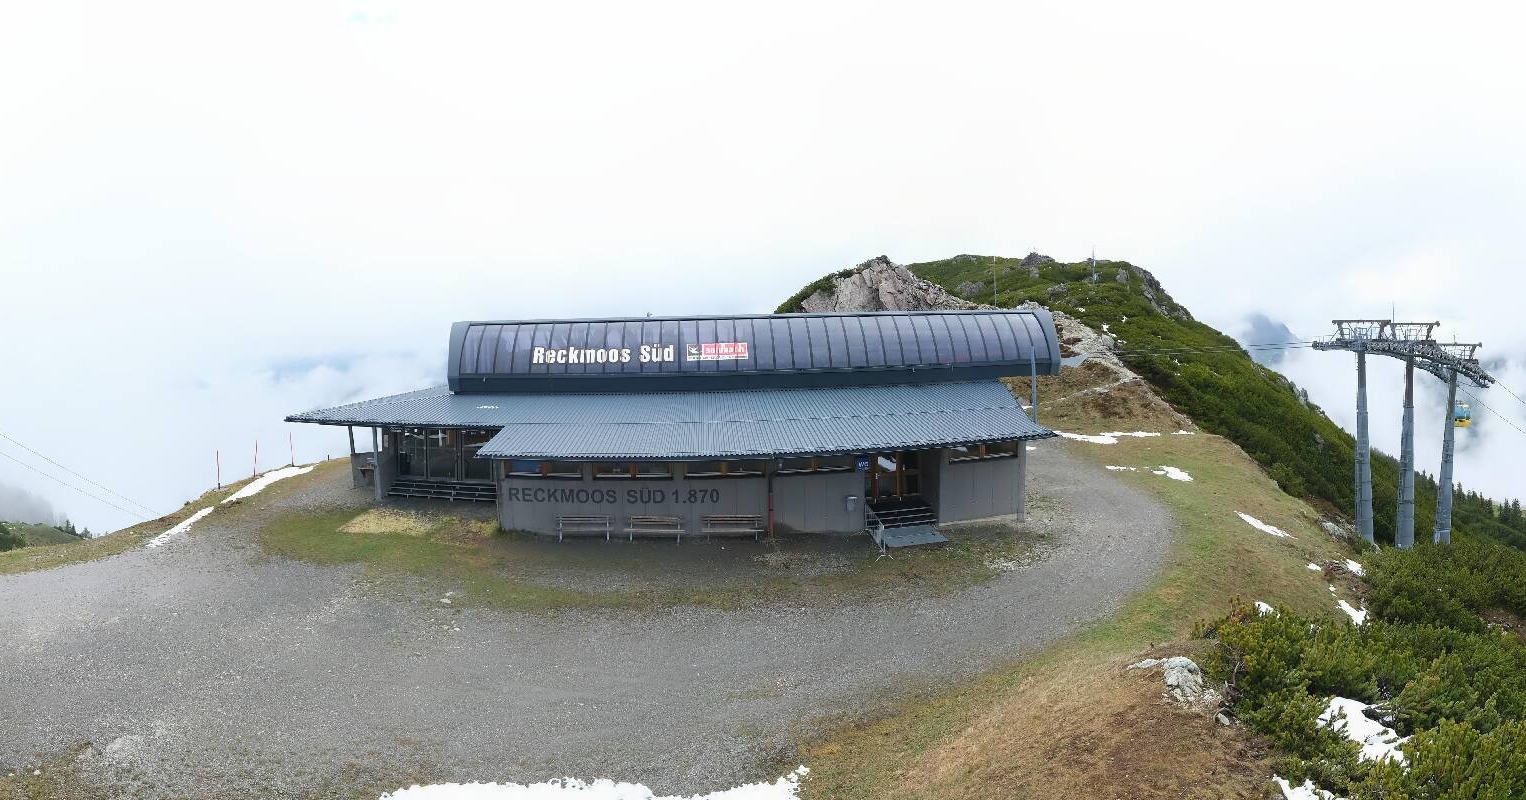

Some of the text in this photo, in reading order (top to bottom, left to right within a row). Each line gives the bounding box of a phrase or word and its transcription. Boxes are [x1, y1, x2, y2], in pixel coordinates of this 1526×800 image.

[532, 343, 674, 364] Reckmoos Süd
[508, 487, 720, 504] RECKMOOS SÜD 1.870
